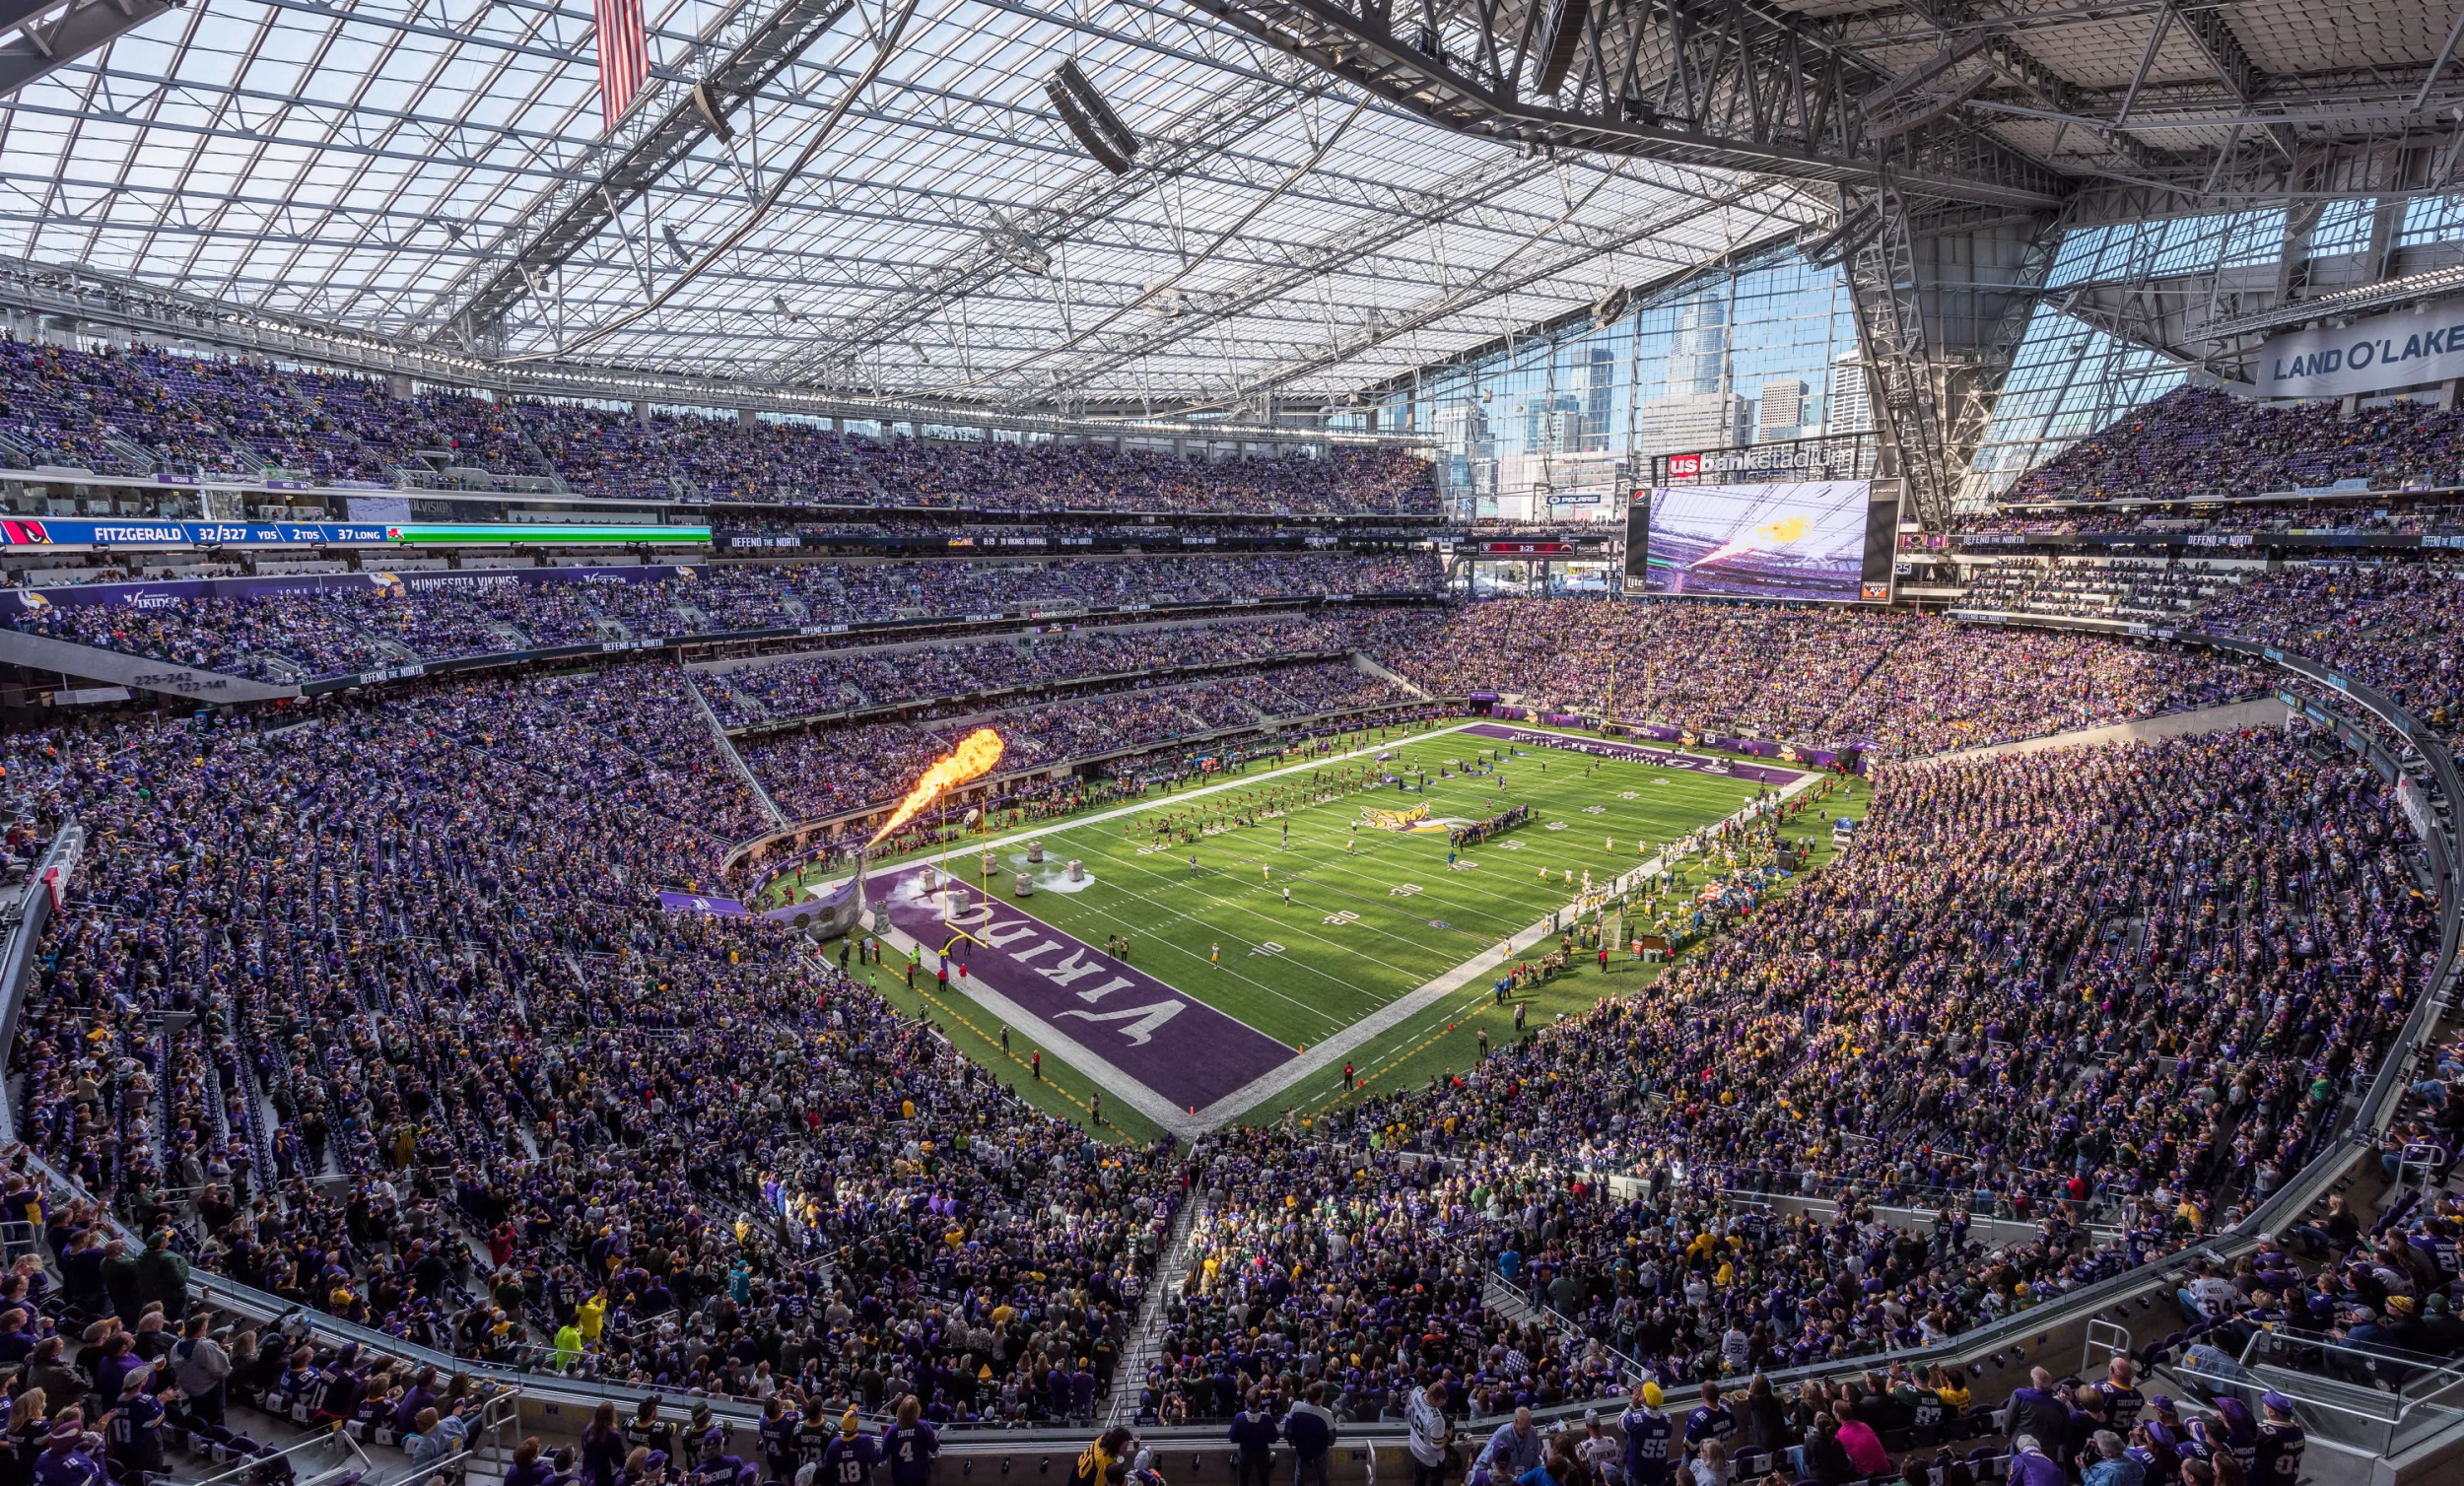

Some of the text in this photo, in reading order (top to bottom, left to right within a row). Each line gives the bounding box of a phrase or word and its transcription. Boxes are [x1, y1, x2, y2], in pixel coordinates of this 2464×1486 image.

[2274, 348, 2342, 380] LAND
[95, 527, 181, 541] FITZGERALD
[199, 525, 246, 542] 32/327
[257, 530, 278, 540] YDS
[338, 529, 353, 540] 37
[355, 531, 380, 540] LONG
[2188, 535, 2217, 544] DEFEND
[732, 538, 761, 547] DEFEND
[2422, 536, 2441, 546] DEFEND
[411, 575, 518, 591] MINNESOTA VIKINGS
[1627, 577, 1643, 588] Lite
[603, 642, 629, 650] DEFEND
[641, 639, 664, 648] NORTH
[135, 672, 193, 686] 225-242
[361, 671, 386, 684] DEFEND
[400, 665, 424, 678] NORTH
[177, 680, 227, 692] 122-141
[1392, 883, 1423, 897] 30
[1325, 911, 1360, 926] 20
[1251, 942, 1287, 958] 10
[1124, 1285, 1137, 1297] 52
[2207, 1299, 2233, 1315] 84
[493, 1334, 511, 1348] 12
[1461, 1336, 1478, 1349] 28
[1731, 1343, 1743, 1354] 28
[359, 1409, 375, 1419] FAVRE
[1632, 1411, 1644, 1423] 55
[1914, 1407, 1942, 1425] 87
[112, 1419, 132, 1443] 19
[764, 1429, 781, 1438] FAVRE
[769, 1441, 783, 1456] 4
[899, 1442, 914, 1462] 4
[1641, 1439, 1668, 1458] 55
[1593, 1451, 1618, 1461] FOREMAN
[63, 1458, 79, 1470] 10
[838, 1460, 861, 1484] 18
